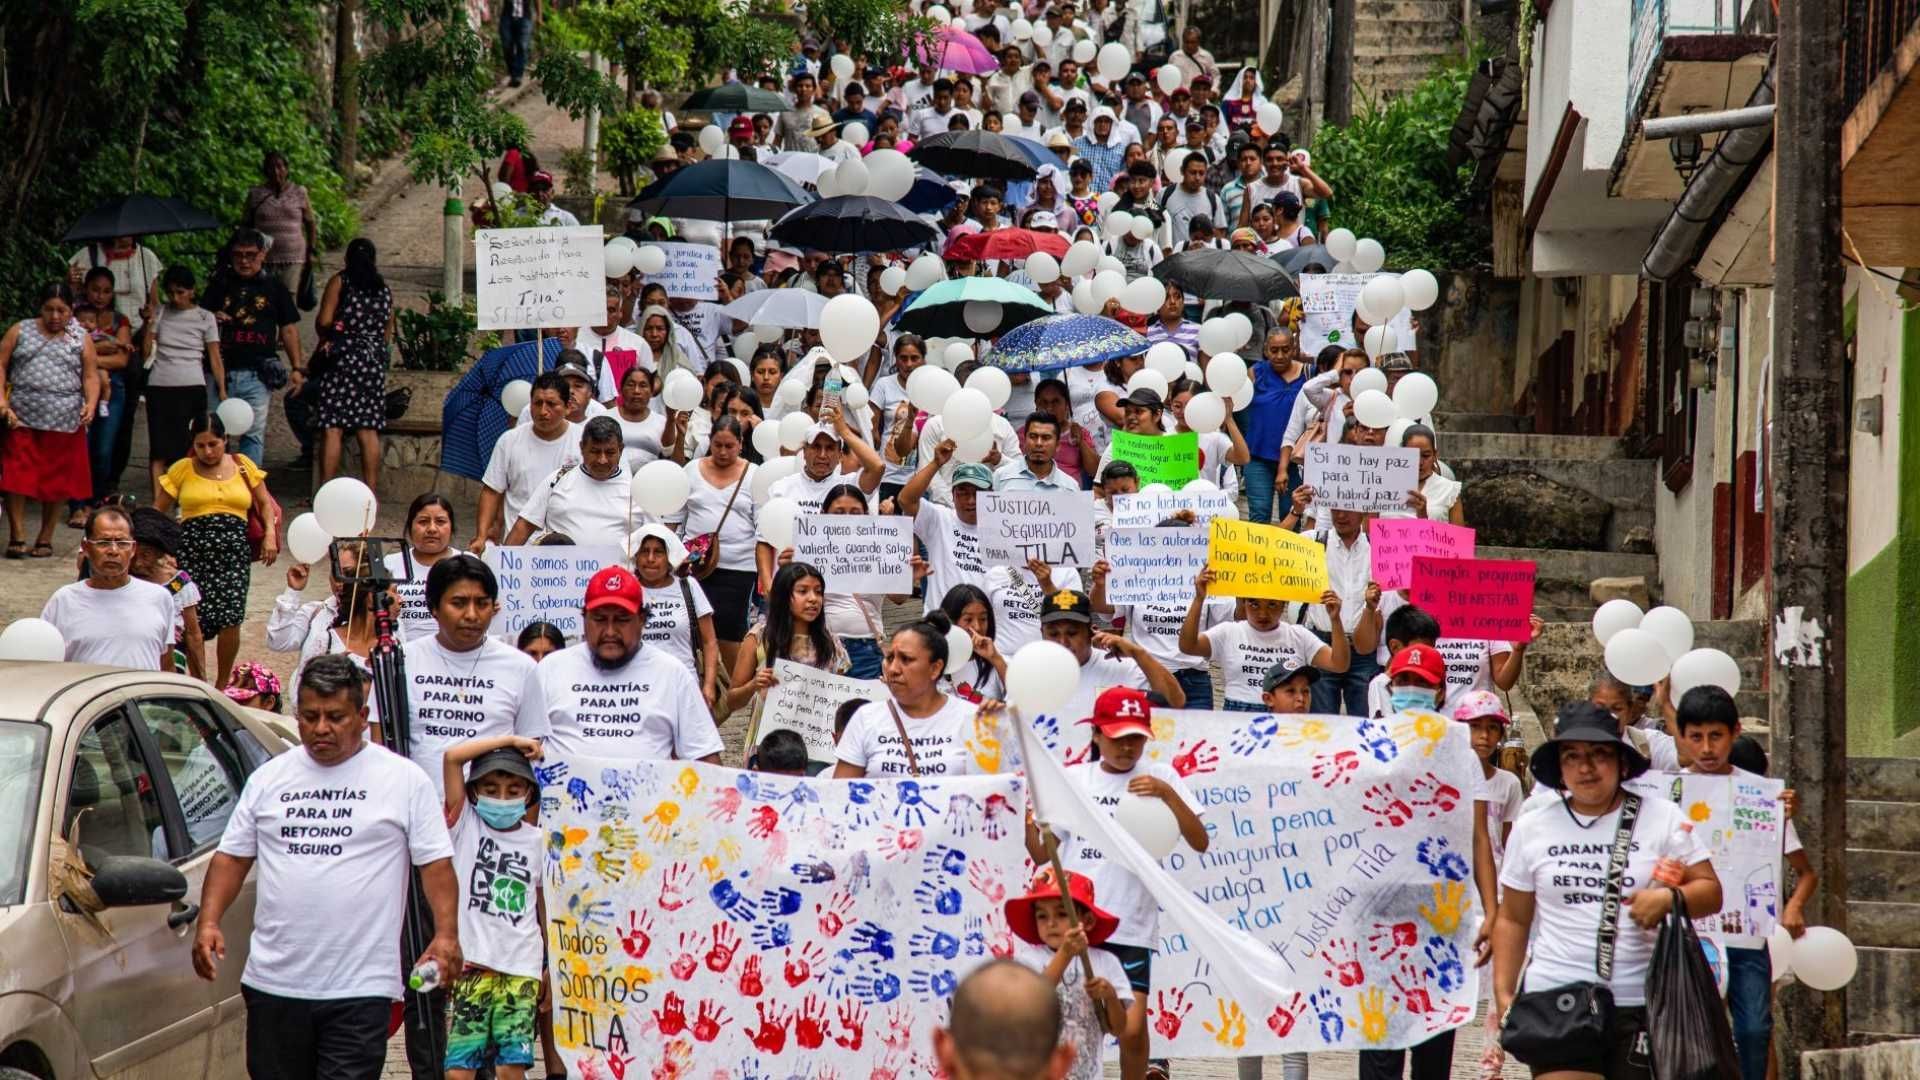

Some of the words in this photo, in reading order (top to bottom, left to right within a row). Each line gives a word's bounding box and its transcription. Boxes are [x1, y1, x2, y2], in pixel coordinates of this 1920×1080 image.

[1338, 455, 1351, 466] no
[1360, 453, 1379, 468] hay
[1386, 458, 1410, 471] paz
[1323, 471, 1349, 485] para
[1358, 470, 1382, 485] Tila
[1375, 491, 1402, 503] paz
[856, 521, 898, 536] sentirme
[1215, 522, 1237, 541] No
[1247, 527, 1269, 549] hay
[799, 541, 839, 554] valiente
[845, 542, 881, 554] cuando
[985, 547, 1010, 560] PARA
[501, 551, 523, 570] No
[531, 557, 569, 570] somos
[1214, 545, 1247, 564] hacia
[1254, 552, 1266, 565] la
[831, 563, 872, 575] sentirme
[500, 574, 521, 590] No
[530, 576, 567, 588] somos
[506, 594, 525, 611] Sr.
[1245, 654, 1273, 663] PARA
[1465, 652, 1480, 660] UN
[414, 675, 495, 689] GARANTÍAS
[571, 682, 650, 693] GARANTÍAS
[1447, 676, 1474, 686] GURO
[424, 691, 460, 703] PARA
[464, 695, 483, 704] UN
[580, 697, 617, 708] PARA
[621, 697, 639, 707] UN
[418, 707, 485, 722] RETORNO
[576, 712, 641, 723] RETORNO
[425, 725, 477, 738] SEGURO
[582, 727, 634, 737] SEGURO
[925, 748, 943, 758] UN
[280, 787, 367, 803] GARANTÍAS
[1268, 780, 1302, 808] por
[285, 807, 328, 819] PARA
[332, 807, 352, 818] UN
[280, 826, 353, 838] RETORNO
[1232, 811, 1255, 838] la
[1272, 808, 1336, 848] pena
[286, 843, 343, 856] SEGURO
[1200, 842, 1299, 889] ninguna
[1324, 828, 1366, 866] por
[1353, 843, 1398, 880] Tila
[1193, 876, 1265, 918] valga
[1282, 866, 1313, 893] la
[552, 919, 608, 955] Todos
[559, 958, 648, 1004] Somos
[559, 1006, 629, 1054] TILA
